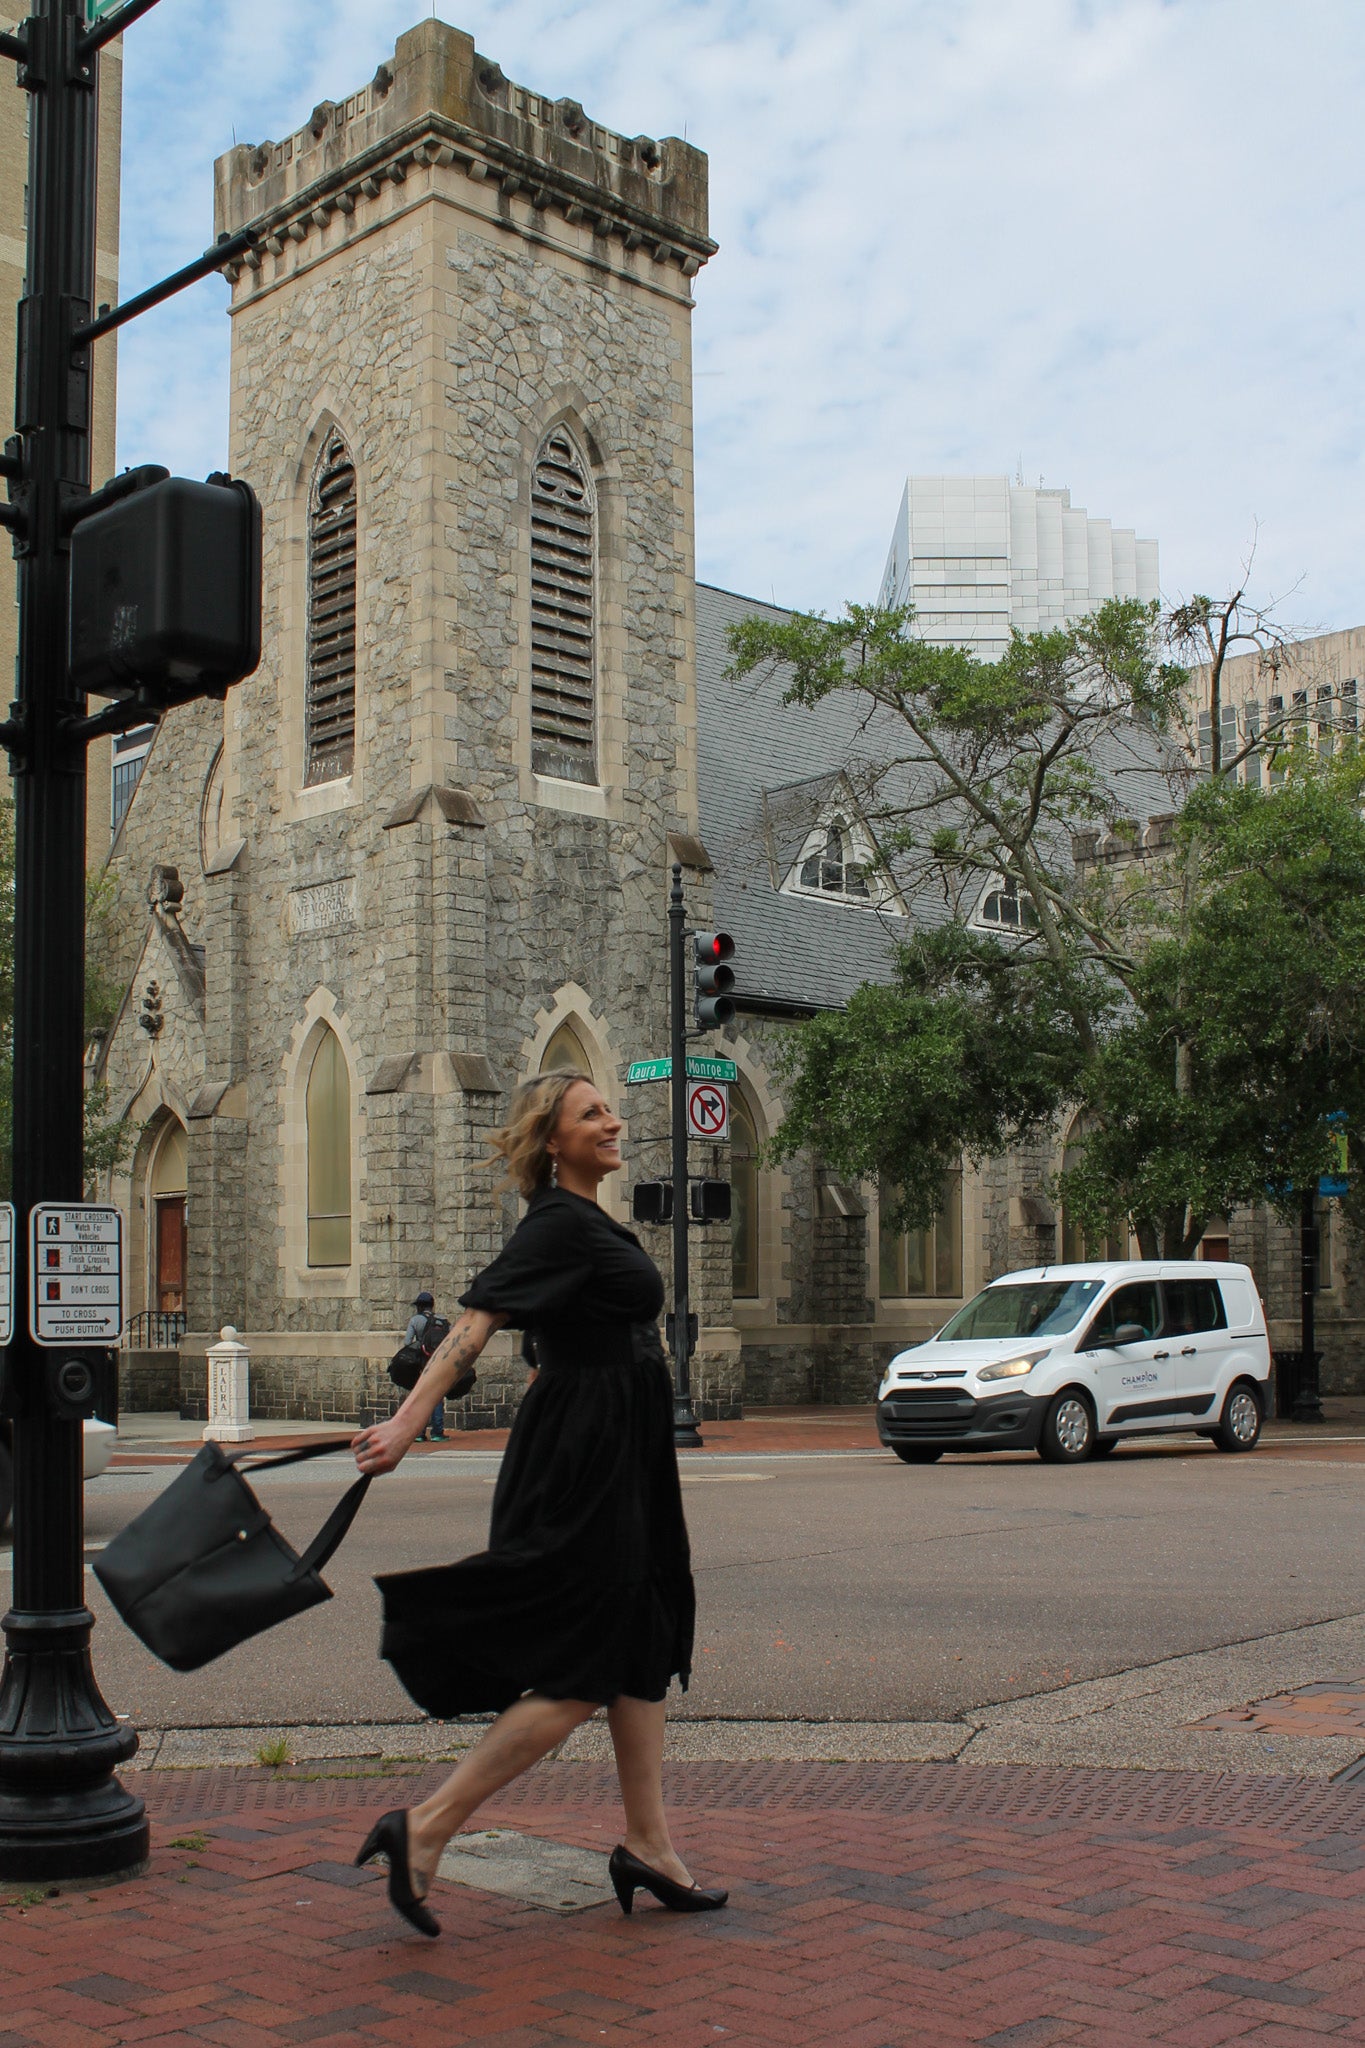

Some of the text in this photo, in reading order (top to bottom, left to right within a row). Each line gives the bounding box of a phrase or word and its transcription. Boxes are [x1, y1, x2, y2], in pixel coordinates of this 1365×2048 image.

[302, 883, 345, 903] SNYDER
[297, 895, 350, 917] MEMORIAL
[314, 908, 354, 927] CHURCH
[630, 1064, 657, 1079] Laura
[688, 1059, 722, 1077] Monroe
[84, 1213, 113, 1221] CROSSING
[90, 1245, 107, 1253] START
[68, 1255, 110, 1265] Finish Crossing
[71, 1286, 110, 1294] DON'T CROSS
[62, 1310, 97, 1318] TO CROSS
[55, 1325, 104, 1334] PUSH BUTTON
[1121, 1371, 1158, 1385] CHAMPION
[220, 1368, 228, 1411] LAURA
